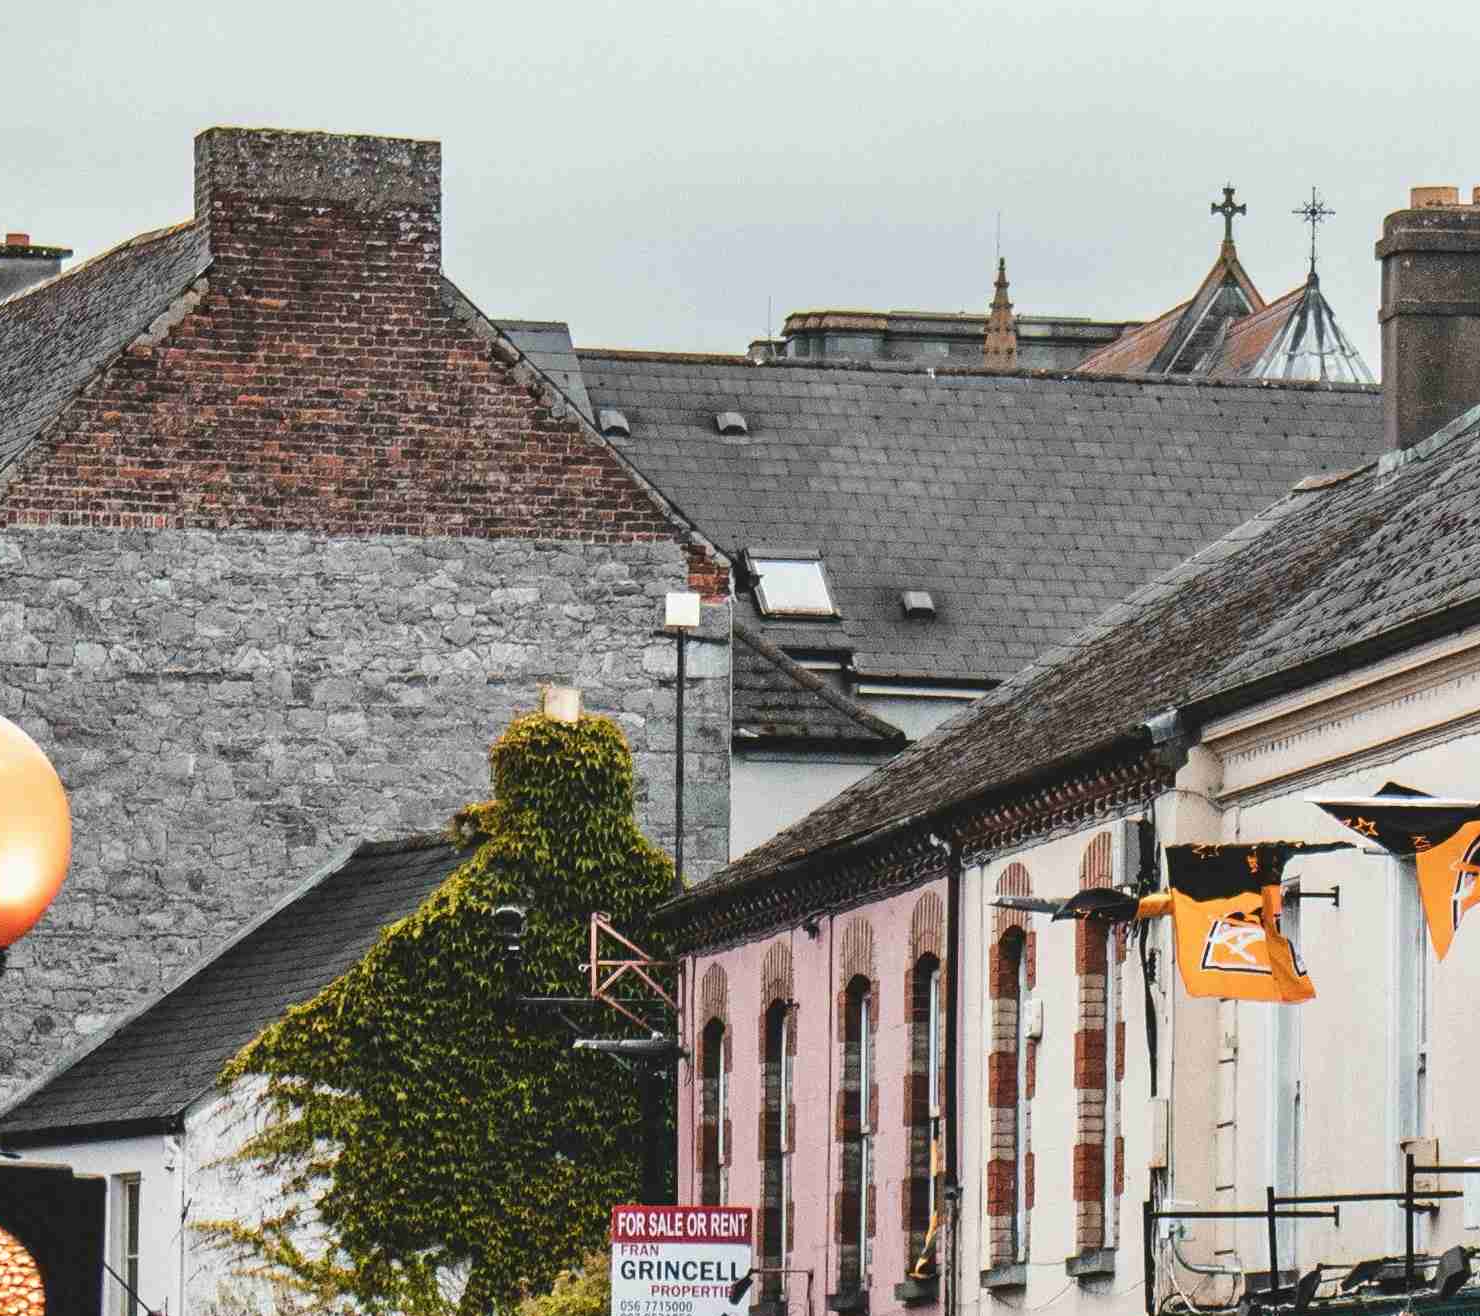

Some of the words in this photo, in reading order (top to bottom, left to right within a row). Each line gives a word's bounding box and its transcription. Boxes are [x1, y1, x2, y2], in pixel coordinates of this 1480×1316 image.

[617, 1212, 645, 1237] FOR
[648, 1212, 684, 1237] SALE
[686, 1212, 707, 1237] OR
[710, 1212, 748, 1237] RENT
[620, 1244, 660, 1257] FRAN
[621, 1260, 740, 1281] GRINCELL
[651, 1284, 734, 1298] PROPERTIE
[620, 1301, 641, 1312] 056
[645, 1301, 693, 1312] 7715000
